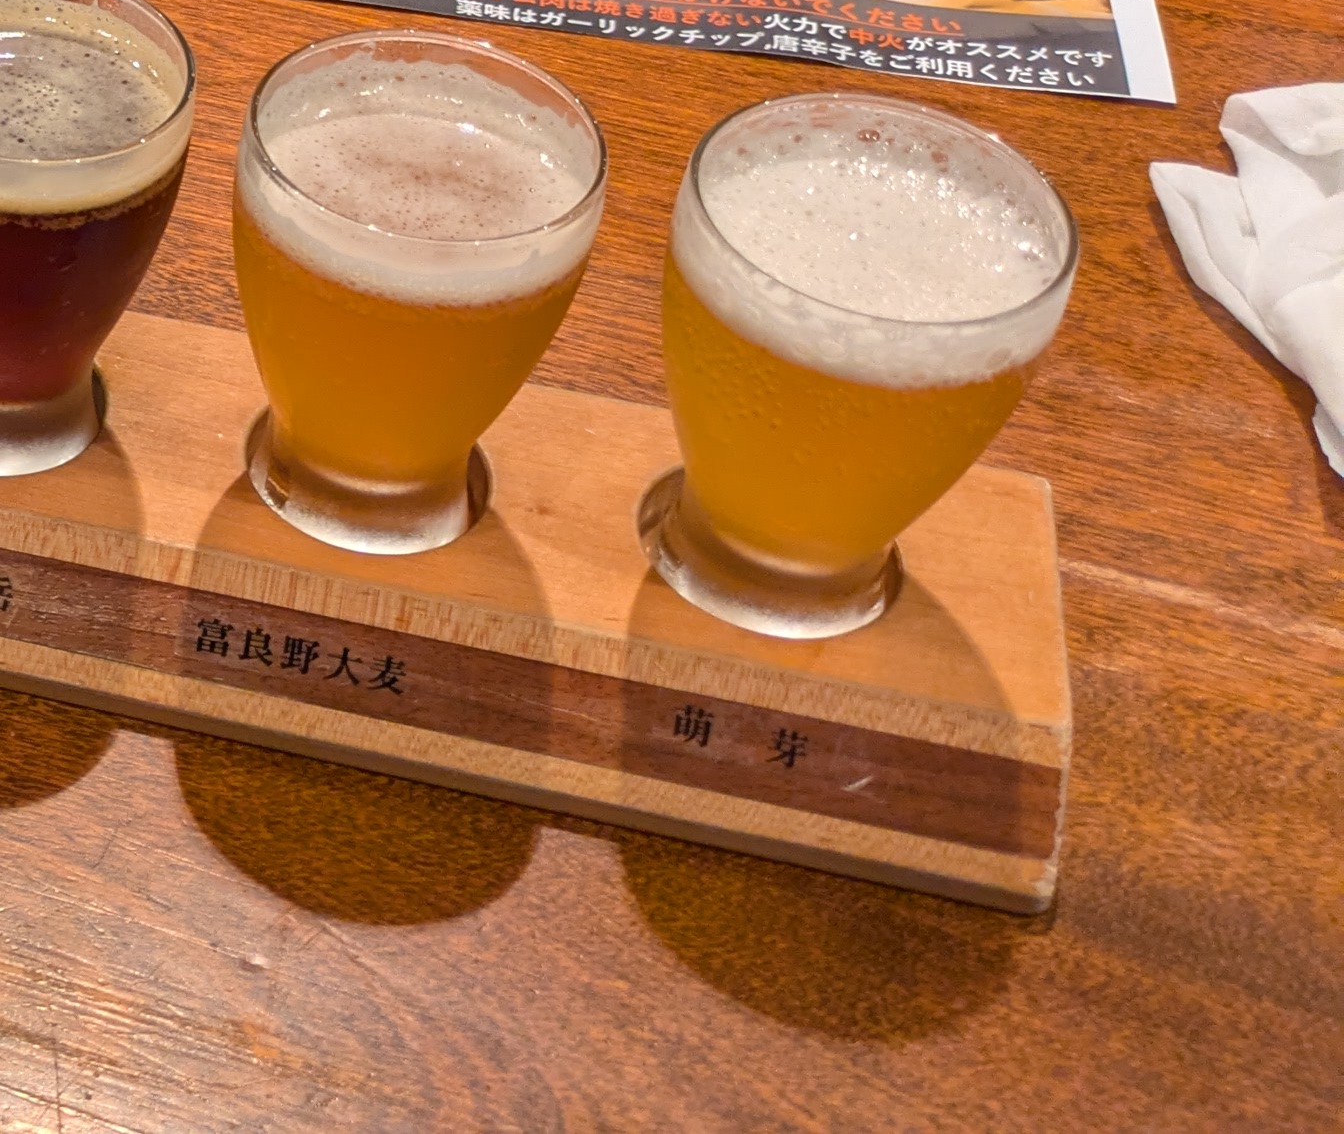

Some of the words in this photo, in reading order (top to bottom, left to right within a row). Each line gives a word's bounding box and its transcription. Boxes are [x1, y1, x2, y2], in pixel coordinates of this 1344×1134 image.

[196, 618, 407, 696] 富良野大麦
